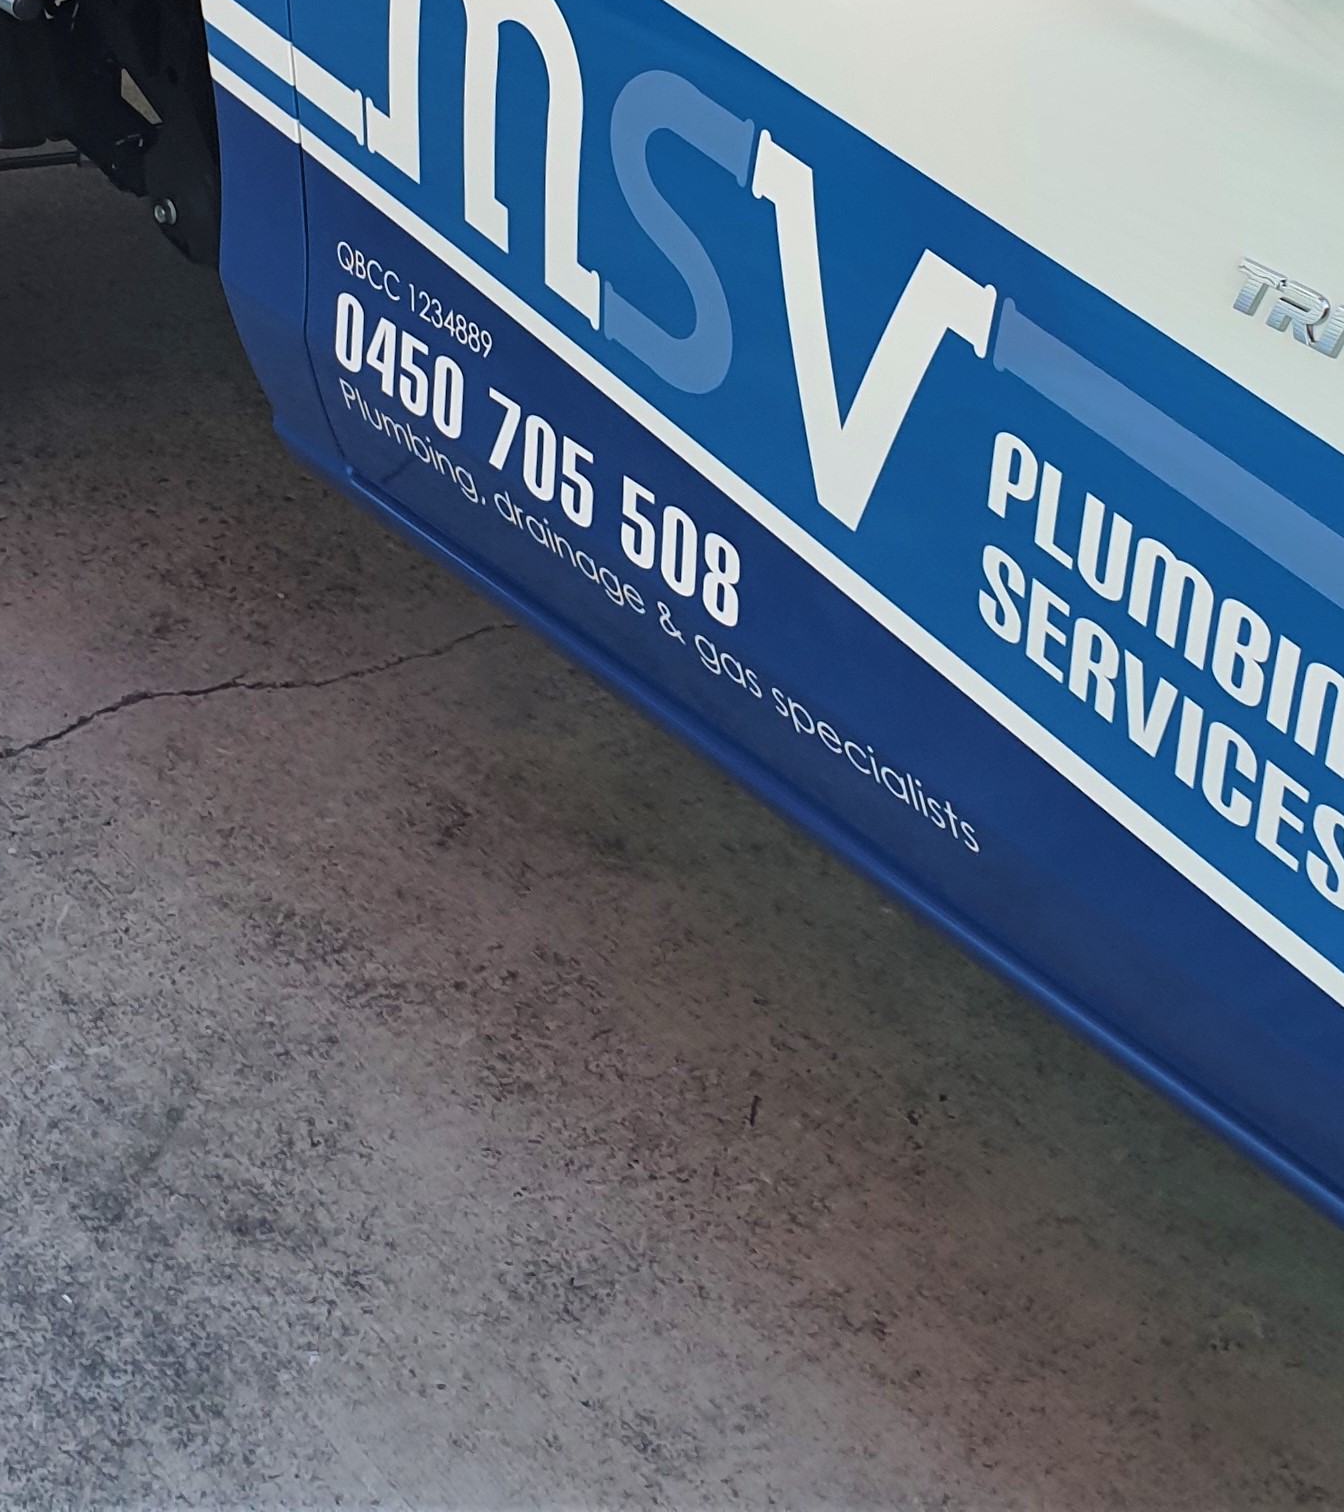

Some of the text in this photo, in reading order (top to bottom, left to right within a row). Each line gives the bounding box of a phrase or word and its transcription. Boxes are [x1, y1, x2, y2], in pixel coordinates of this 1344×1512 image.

[335, 292, 741, 628] 0450 705 508
[336, 241, 493, 358] QBCC 1234889
[494, 490, 646, 615] drainage
[656, 600, 687, 645] &
[693, 633, 763, 699] gas
[770, 686, 981, 854] specialists
